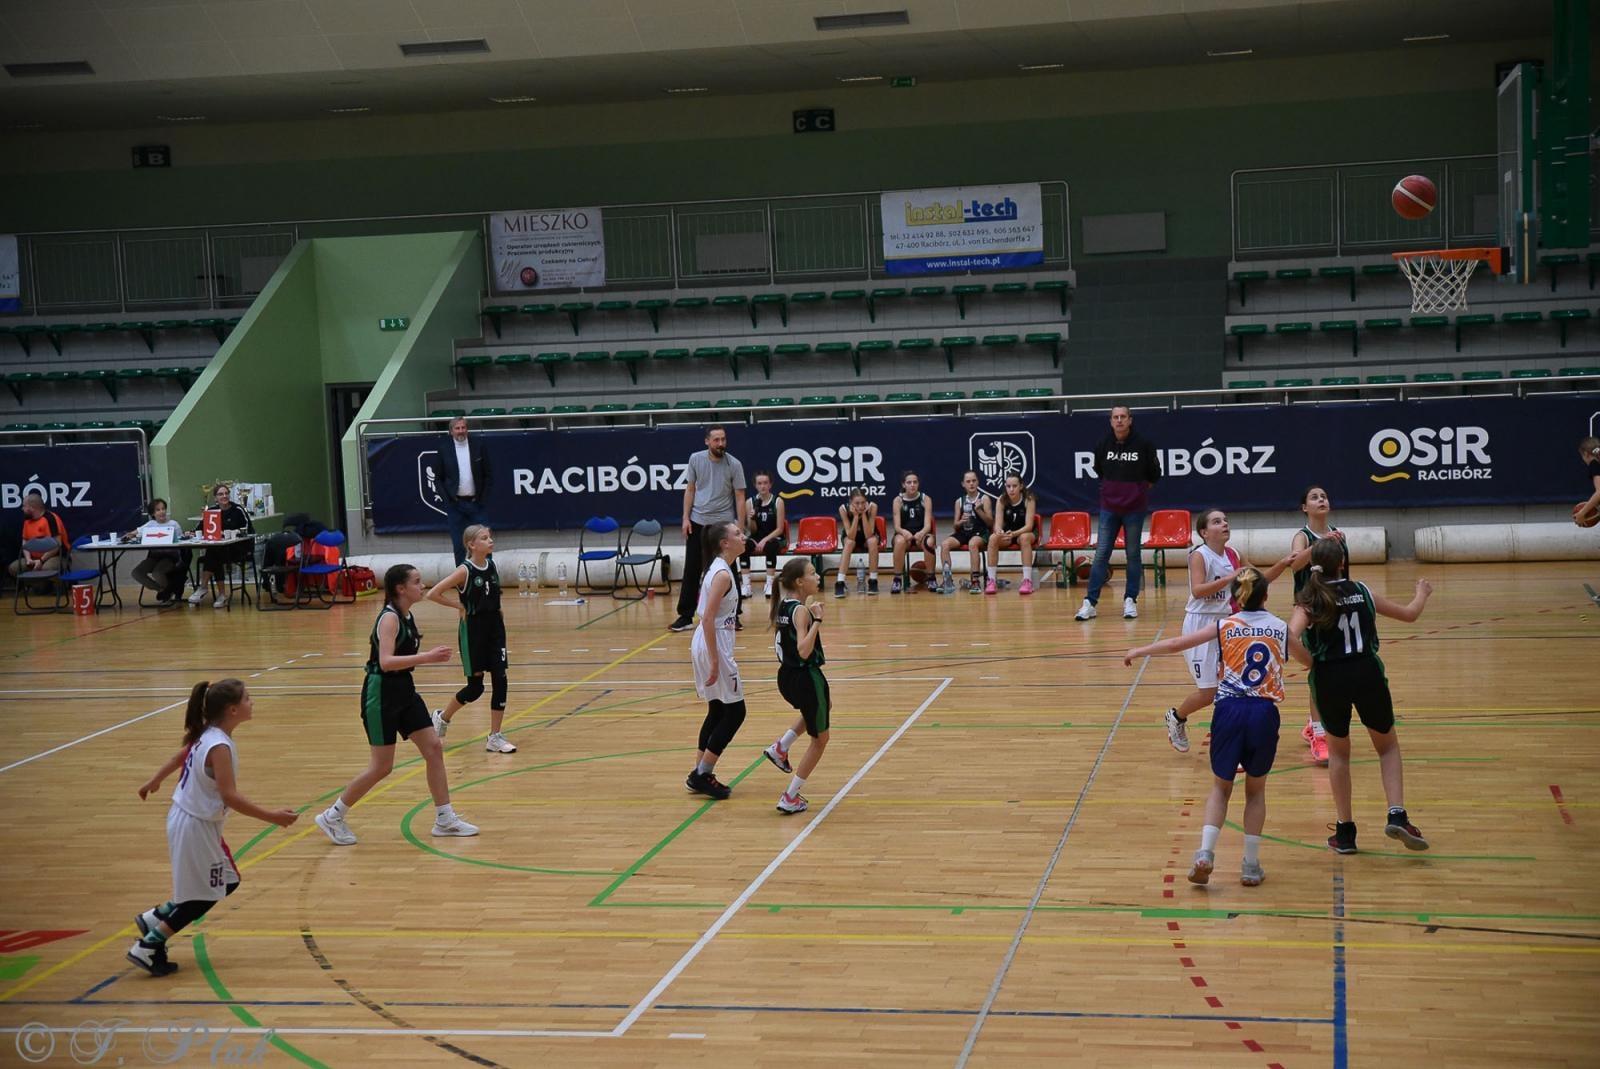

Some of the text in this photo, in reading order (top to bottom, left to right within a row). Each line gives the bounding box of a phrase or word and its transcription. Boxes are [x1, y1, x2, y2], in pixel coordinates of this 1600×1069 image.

[816, 116, 831, 129] C
[149, 153, 164, 165] B
[905, 197, 1018, 227] instal-tech
[504, 212, 588, 233] MIESZKO
[926, 257, 1001, 268] www.instal-tech.pl
[1074, 437, 1276, 479] RIBÓRZ
[1106, 451, 1139, 462] PARIS
[1418, 466, 1492, 480] RACIBÓRZ
[206, 514, 218, 534] 5
[80, 588, 91, 608] 5
[1226, 625, 1285, 642] RACIBÓRZ
[1337, 611, 1363, 654] 11
[1194, 663, 1201, 679] 9
[1241, 641, 1271, 687] 8
[732, 677, 738, 693] 7
